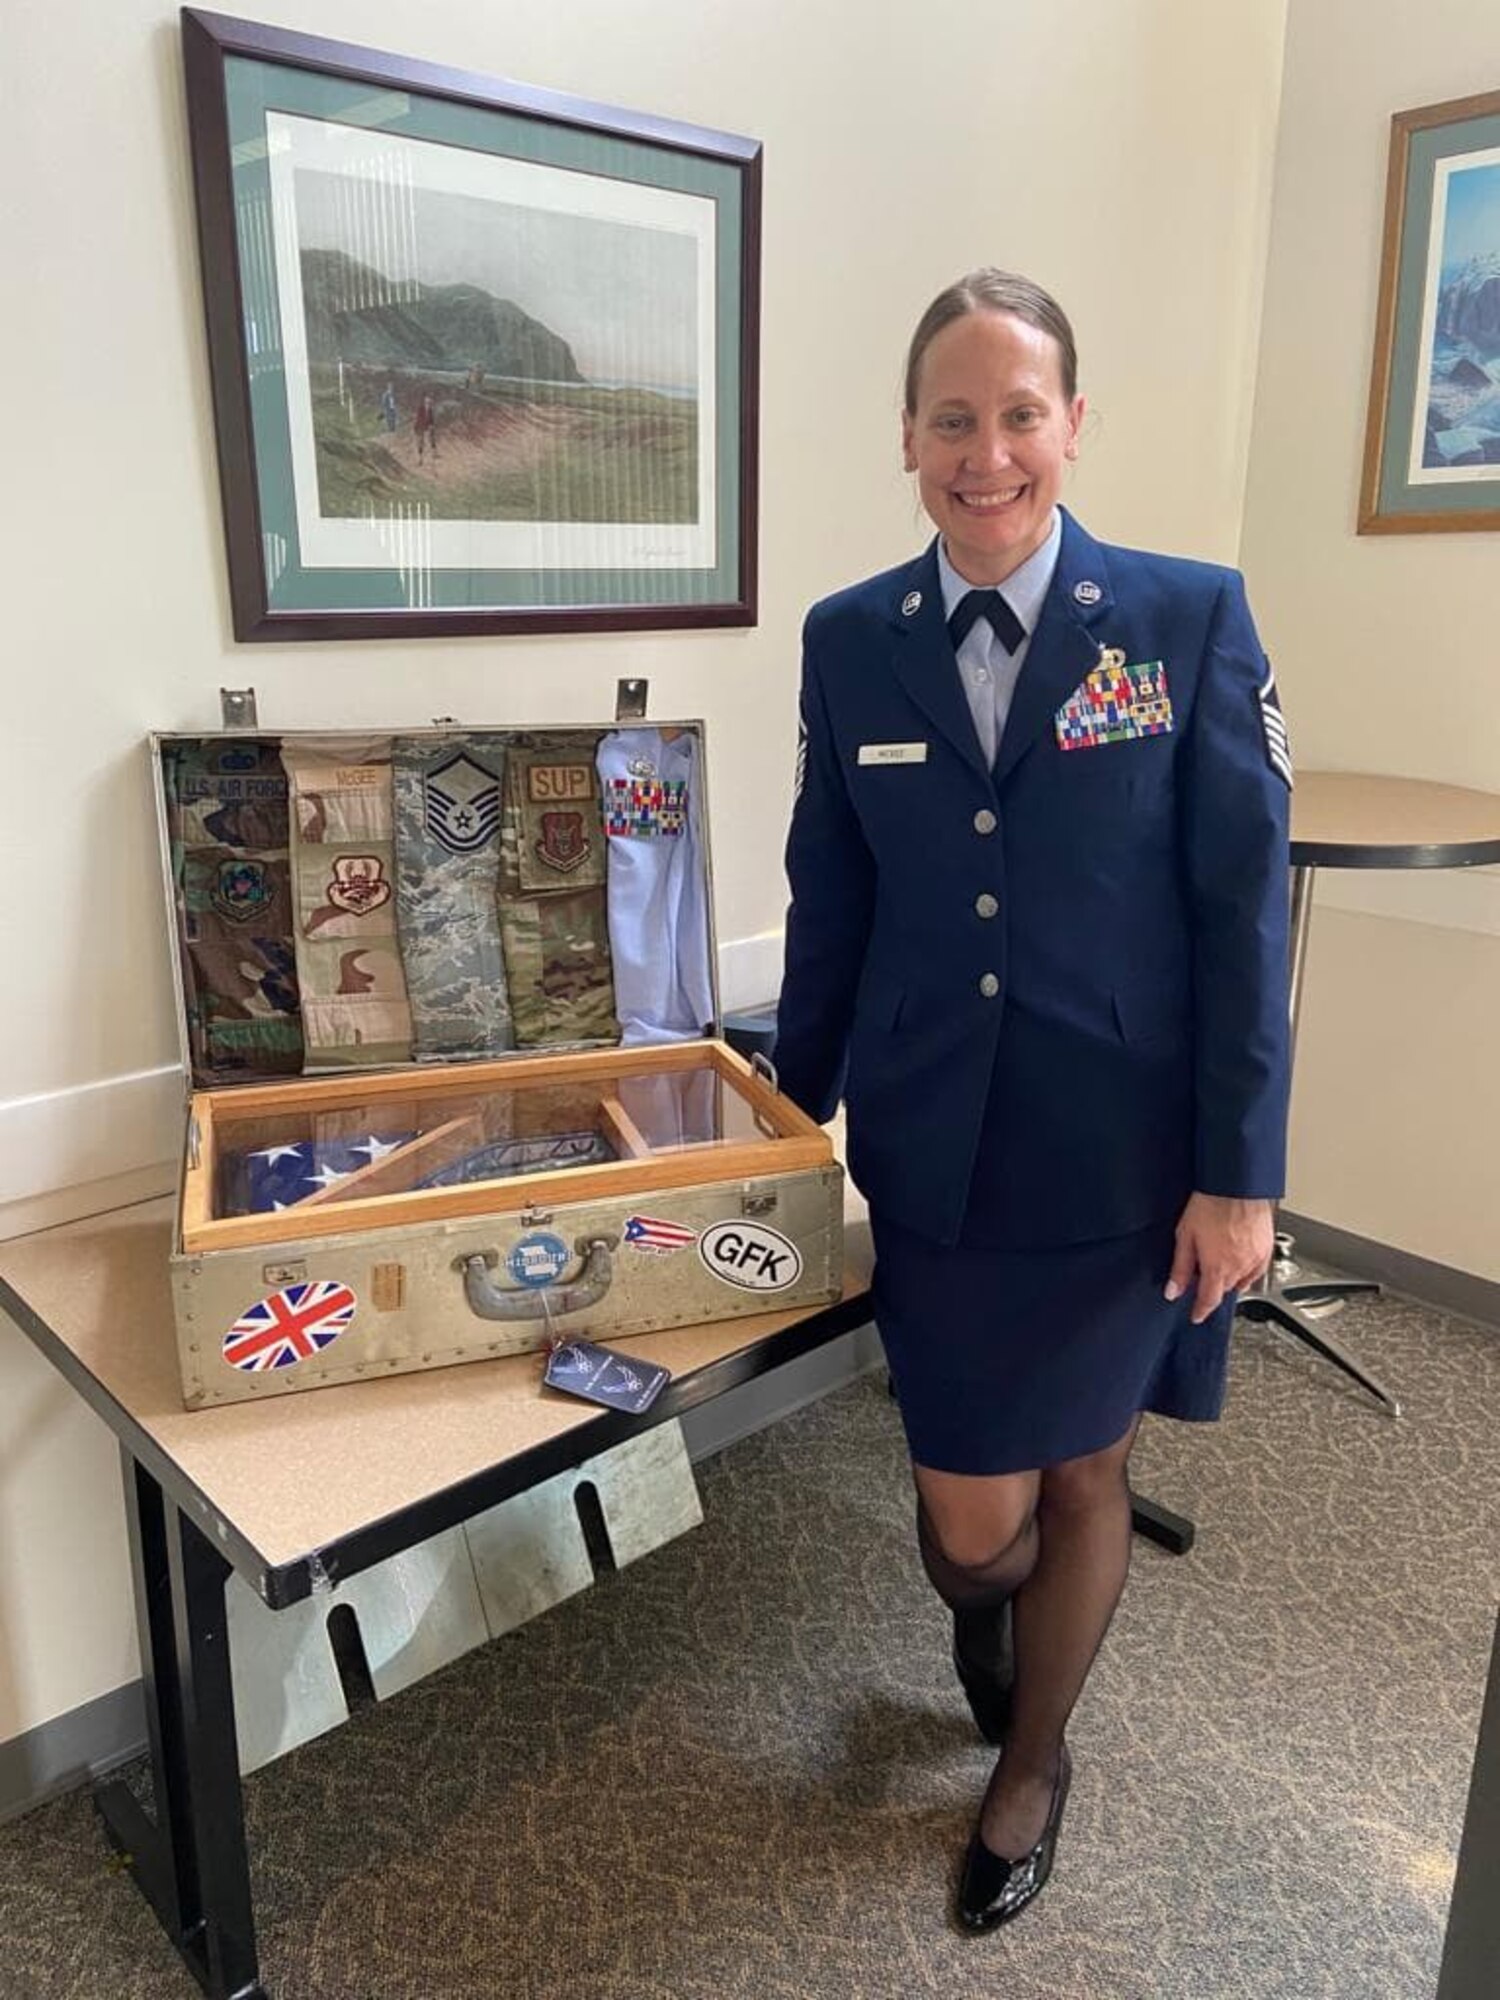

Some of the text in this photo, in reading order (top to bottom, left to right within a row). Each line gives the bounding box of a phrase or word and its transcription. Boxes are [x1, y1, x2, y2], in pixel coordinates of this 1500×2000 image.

[219, 779, 242, 798] AIR
[245, 779, 286, 797] FORC
[535, 769, 586, 796] SUP
[714, 1232, 790, 1283] GFK
